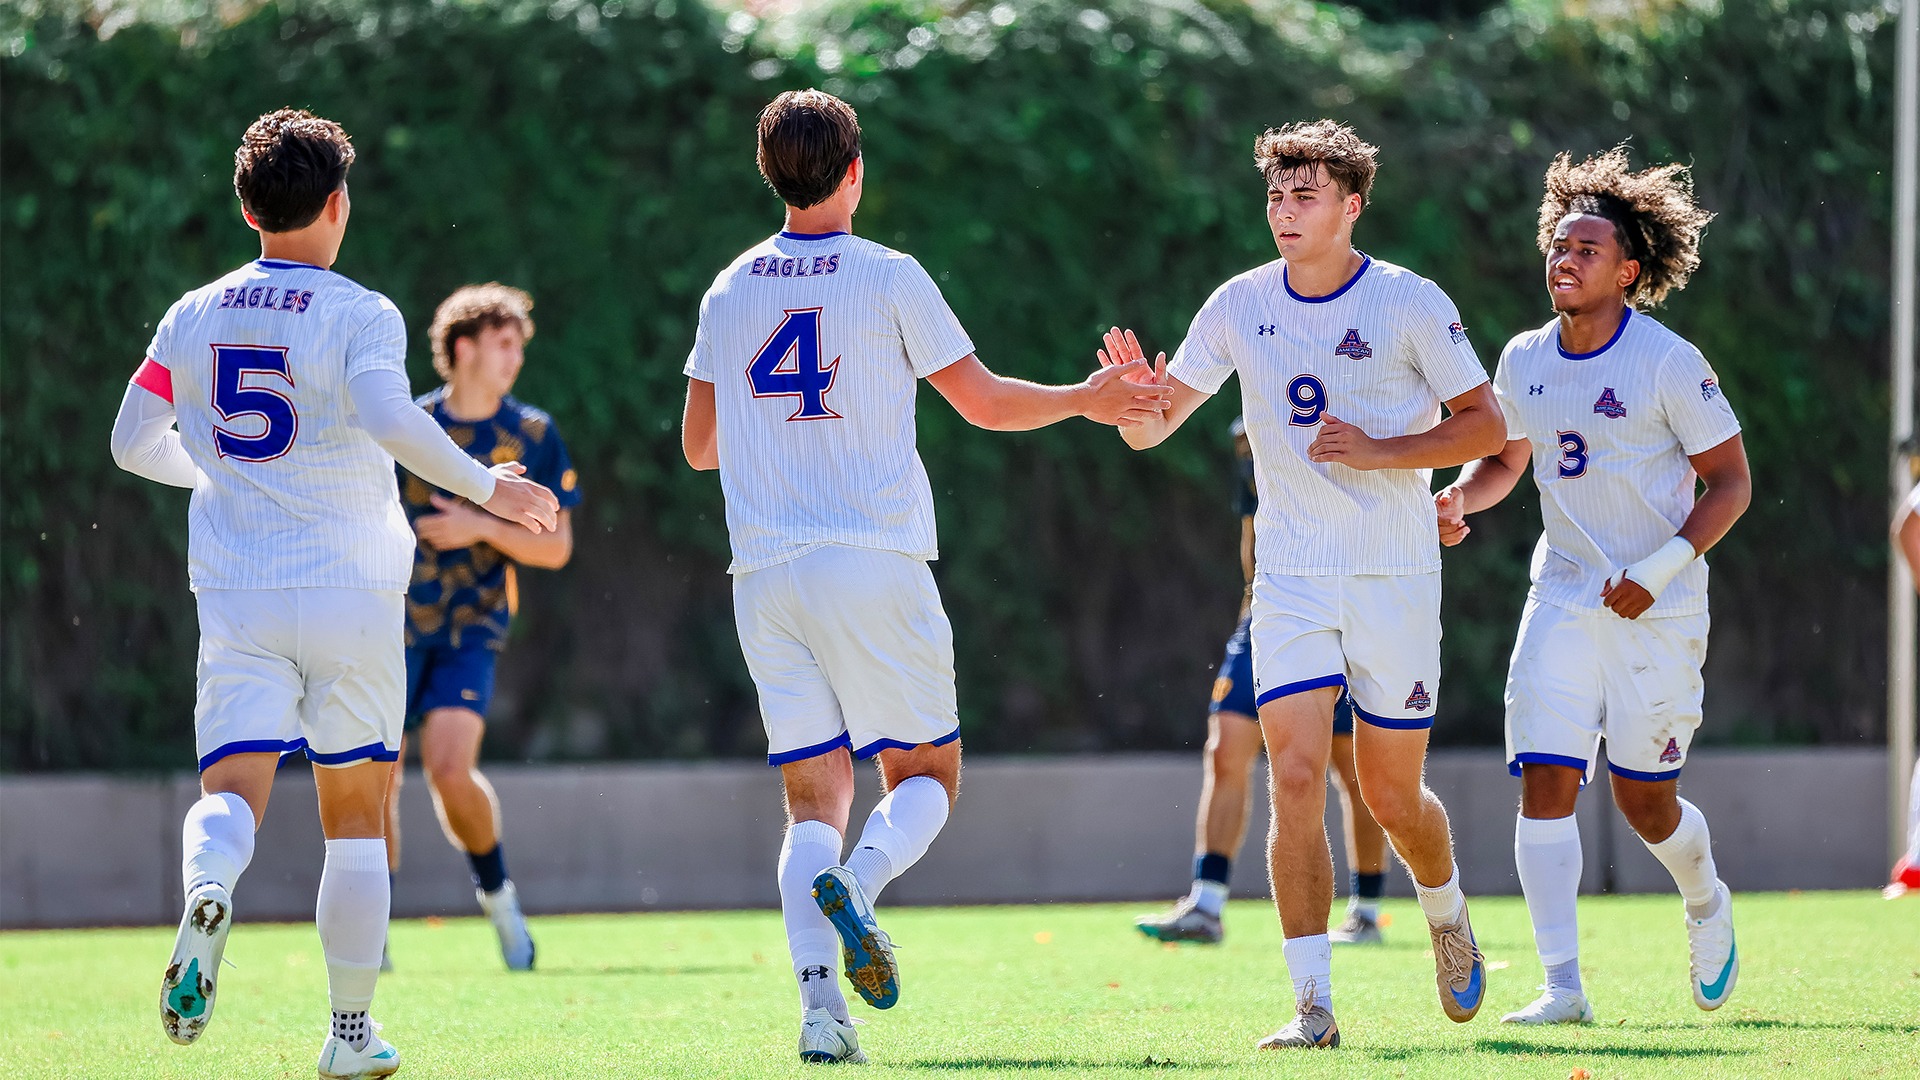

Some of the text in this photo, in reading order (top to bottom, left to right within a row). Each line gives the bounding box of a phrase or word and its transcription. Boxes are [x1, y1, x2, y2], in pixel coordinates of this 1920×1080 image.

[748, 253, 841, 278] EAGLES
[217, 286, 315, 314] EAGLES
[745, 306, 844, 422] 4
[209, 343, 299, 463] 5
[1286, 373, 1329, 428] 9
[1556, 430, 1589, 480] 3
